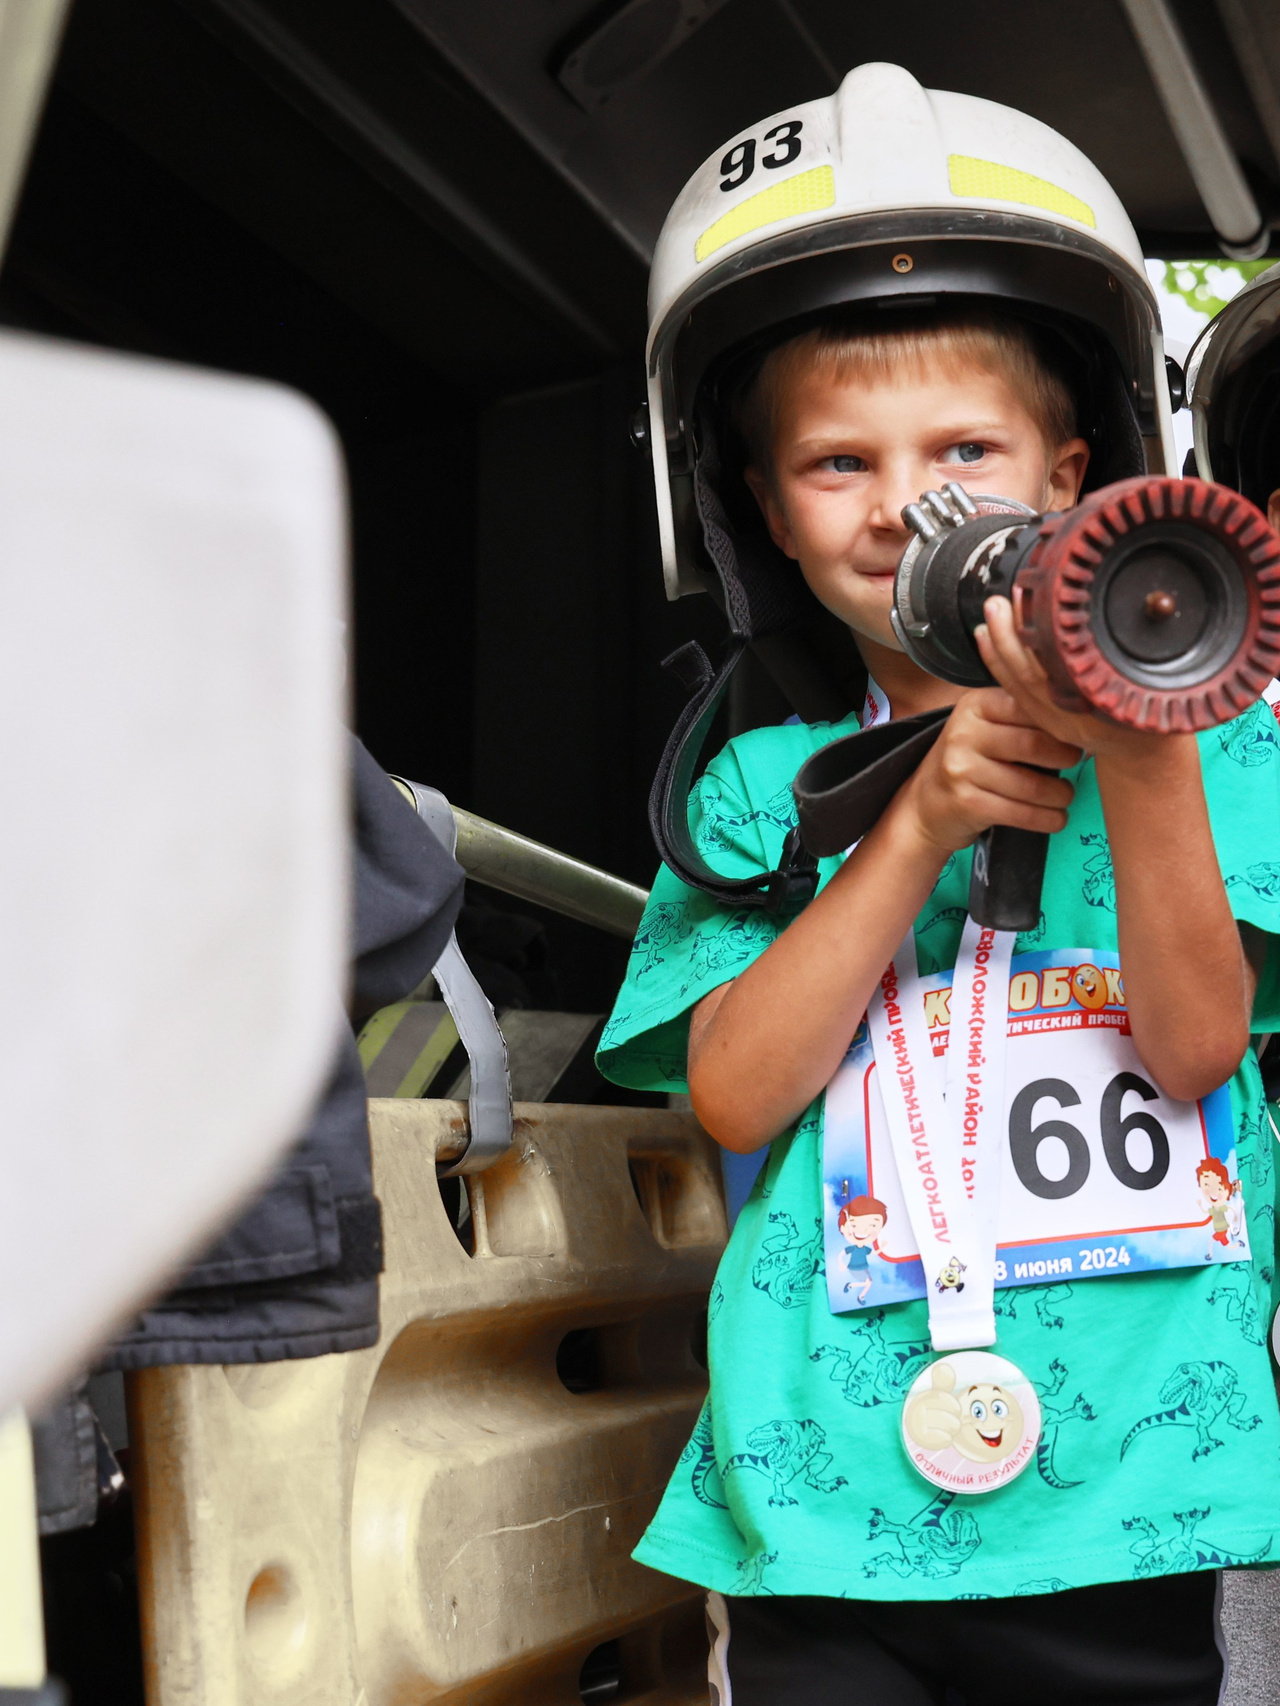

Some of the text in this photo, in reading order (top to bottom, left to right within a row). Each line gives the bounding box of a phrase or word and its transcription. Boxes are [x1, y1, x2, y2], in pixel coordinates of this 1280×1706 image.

[718, 119, 804, 193] 93
[923, 964, 1127, 1030] КОБОК
[880, 961, 952, 1244] ЛЕГКОАТЛЕТИЧЕСКИЙ ПРОБЕ
[962, 1072, 985, 1147] РАЙОН
[994, 1245, 1131, 1280] 8 июня 2024
[915, 1437, 1034, 1485] ОТЛИЧНЫЙ РЕЗУЛЬТАТ
